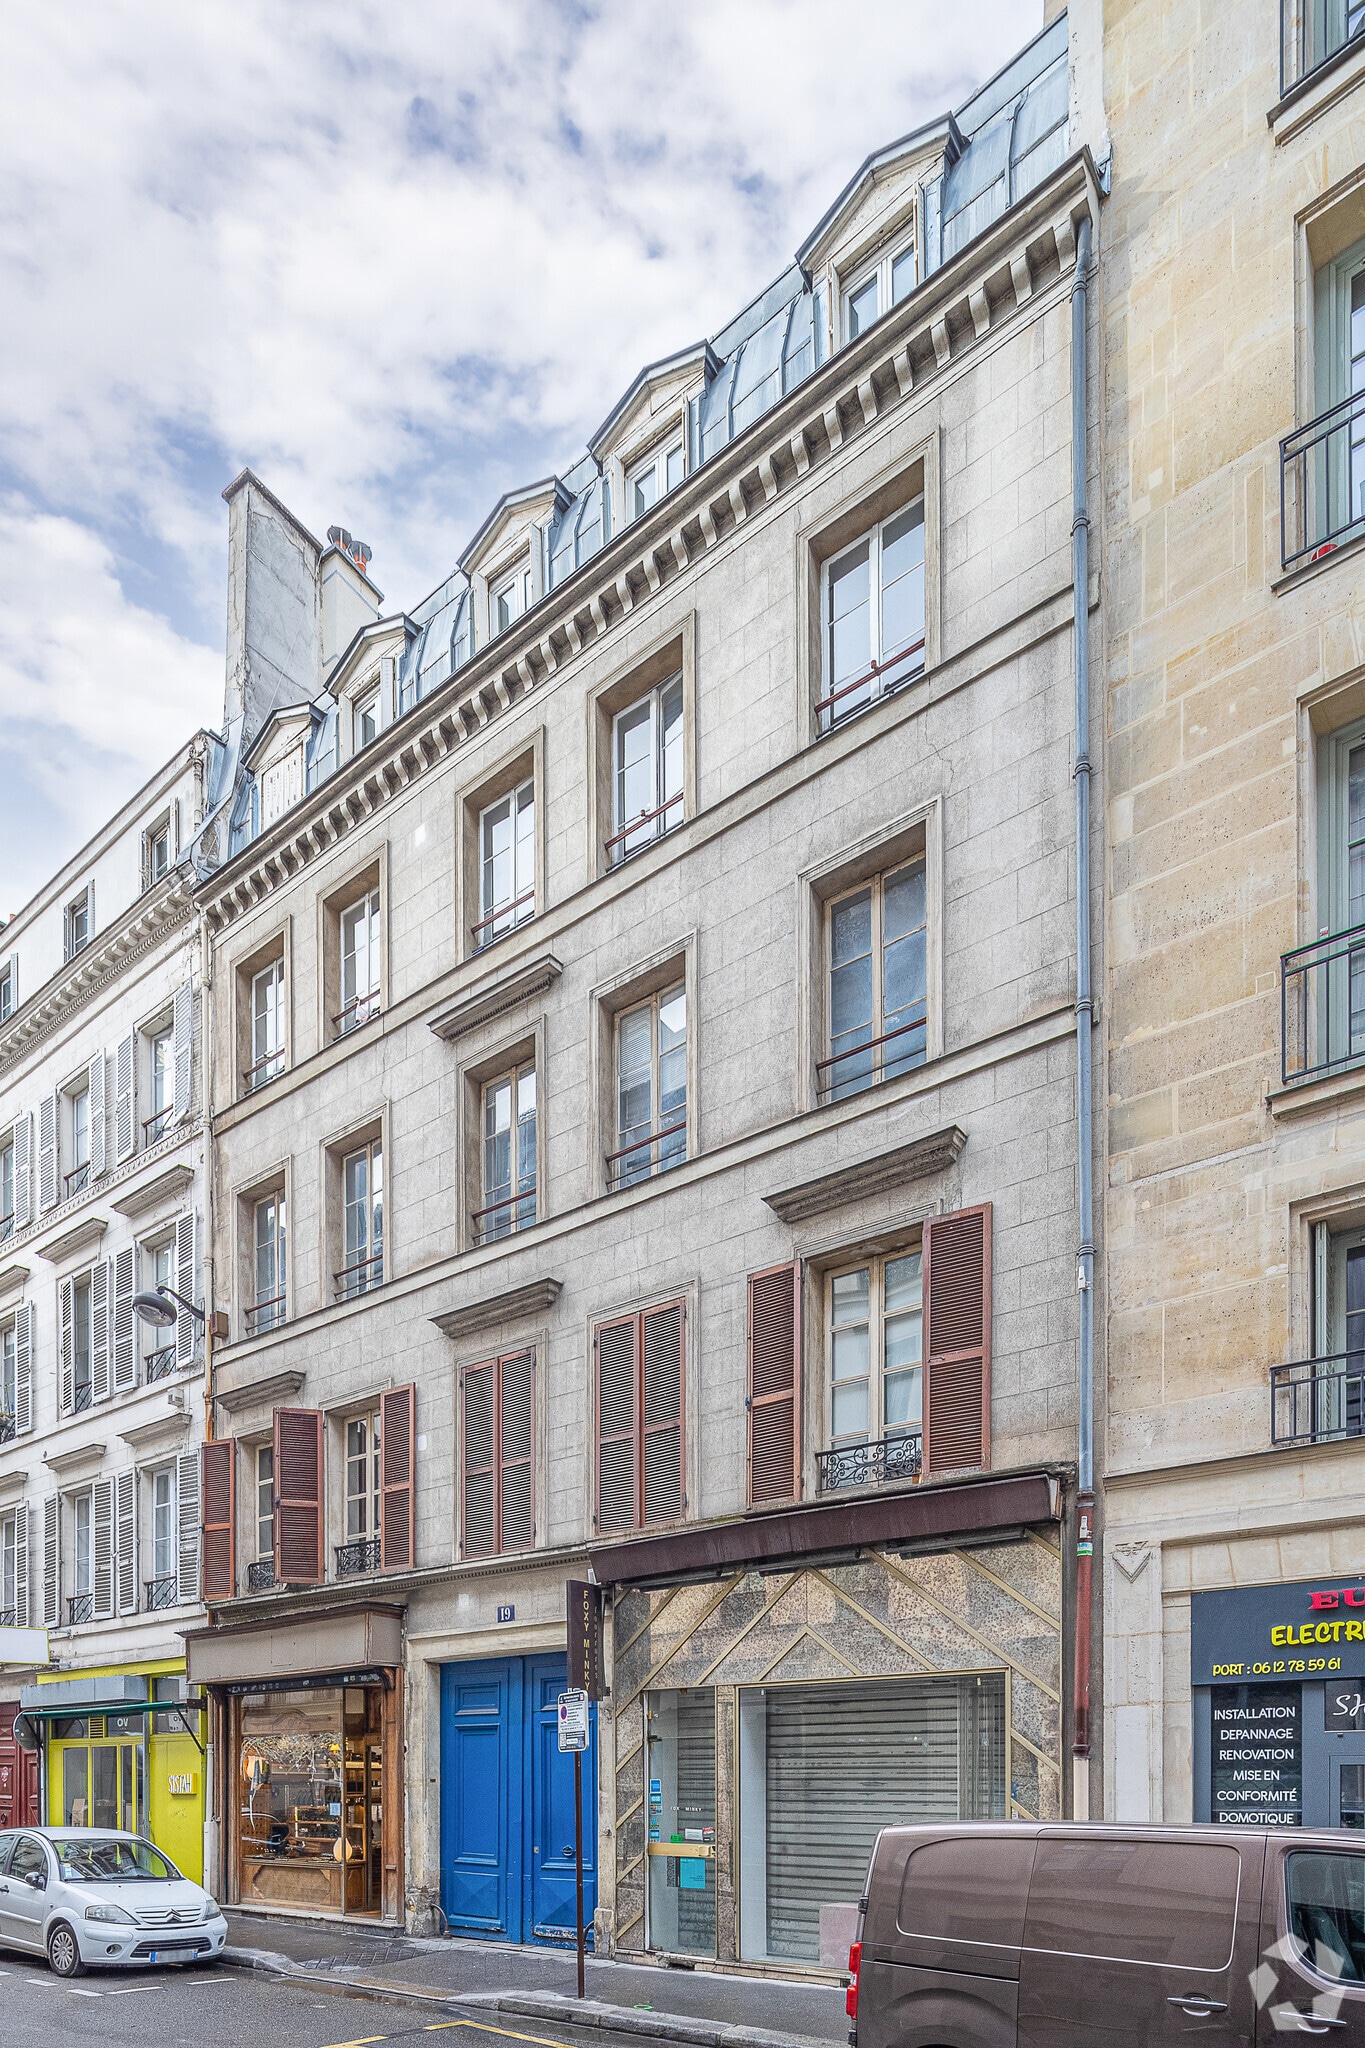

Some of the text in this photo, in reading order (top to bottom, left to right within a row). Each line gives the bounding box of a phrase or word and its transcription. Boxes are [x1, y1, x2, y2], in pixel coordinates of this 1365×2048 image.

[500, 1607, 511, 1621] 19
[1212, 1663, 1244, 1677] PORT
[1252, 1661, 1271, 1675] 06
[1273, 1661, 1285, 1673] 12
[1288, 1659, 1305, 1672] 78
[1307, 1658, 1326, 1671] 59
[1327, 1657, 1341, 1670] 61
[1214, 1706, 1296, 1720] INSTALLATION
[116, 1717, 129, 1727] OV
[1220, 1728, 1294, 1741] DEPANNAGE
[1219, 1749, 1294, 1760] RENOVATION
[1233, 1770, 1280, 1781] MISE EN
[1217, 1788, 1297, 1801] CONFORMITÉ
[1219, 1812, 1294, 1824] DOMOTIQUE
